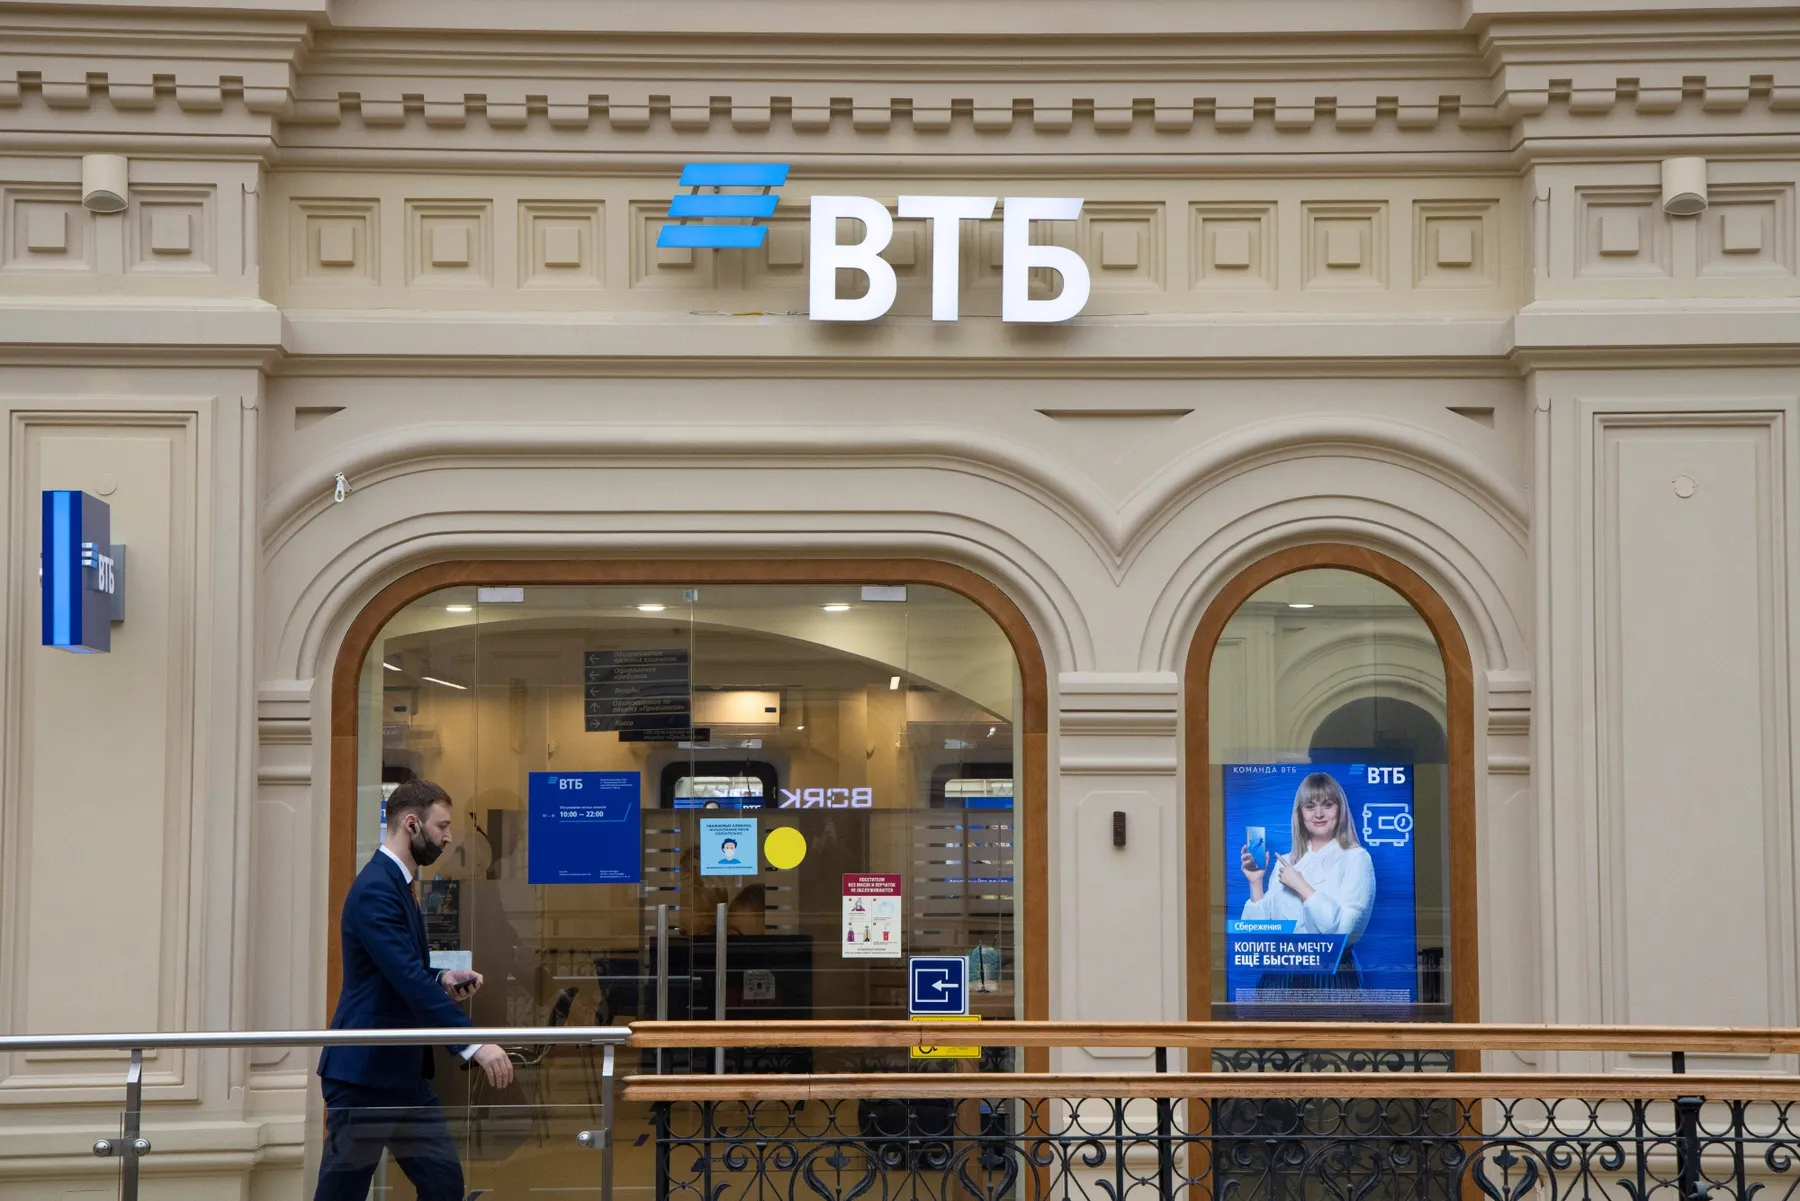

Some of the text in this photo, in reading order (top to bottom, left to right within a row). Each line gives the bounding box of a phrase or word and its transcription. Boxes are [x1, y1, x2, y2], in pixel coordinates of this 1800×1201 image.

[810, 195, 1091, 322] ВТБ
[98, 554, 115, 594] ВТБ
[1368, 767, 1406, 784] ВТБ
[559, 778, 583, 790] ВТБ
[1235, 922, 1281, 932] Сбережения
[1235, 942, 1333, 952] КОПИТЕ НА МЕЧТУ
[1235, 953, 1320, 967] ЕЩЁ БЫСТРЕЕ!
